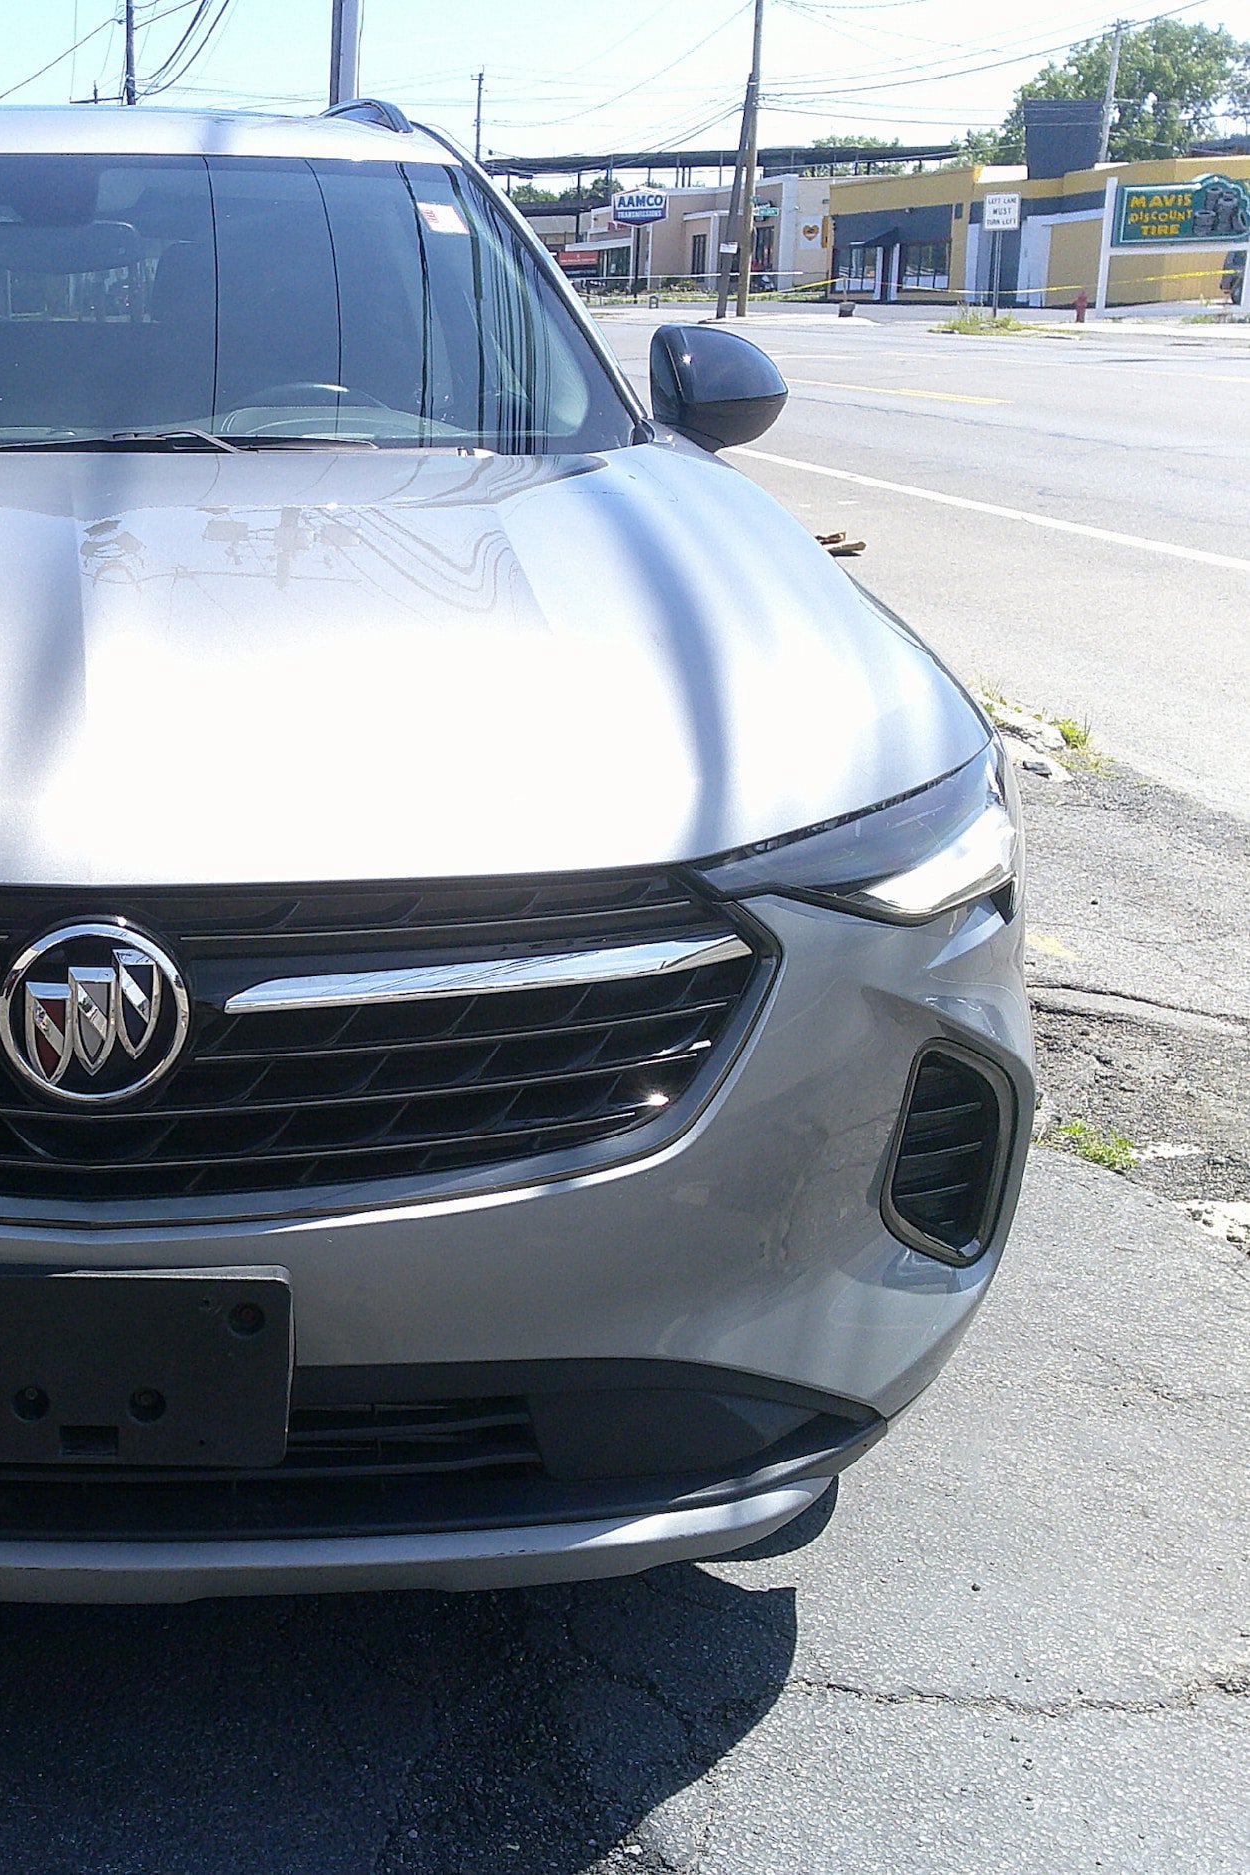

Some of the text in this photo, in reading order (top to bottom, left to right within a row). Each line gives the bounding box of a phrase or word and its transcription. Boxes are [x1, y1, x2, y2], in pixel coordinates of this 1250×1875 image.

[617, 195, 663, 207] AAMCO
[1129, 193, 1192, 208] MAVIS
[993, 207, 1011, 215] MUST
[1128, 209, 1193, 224] DISCOUNT
[1140, 224, 1180, 235] TIRE
